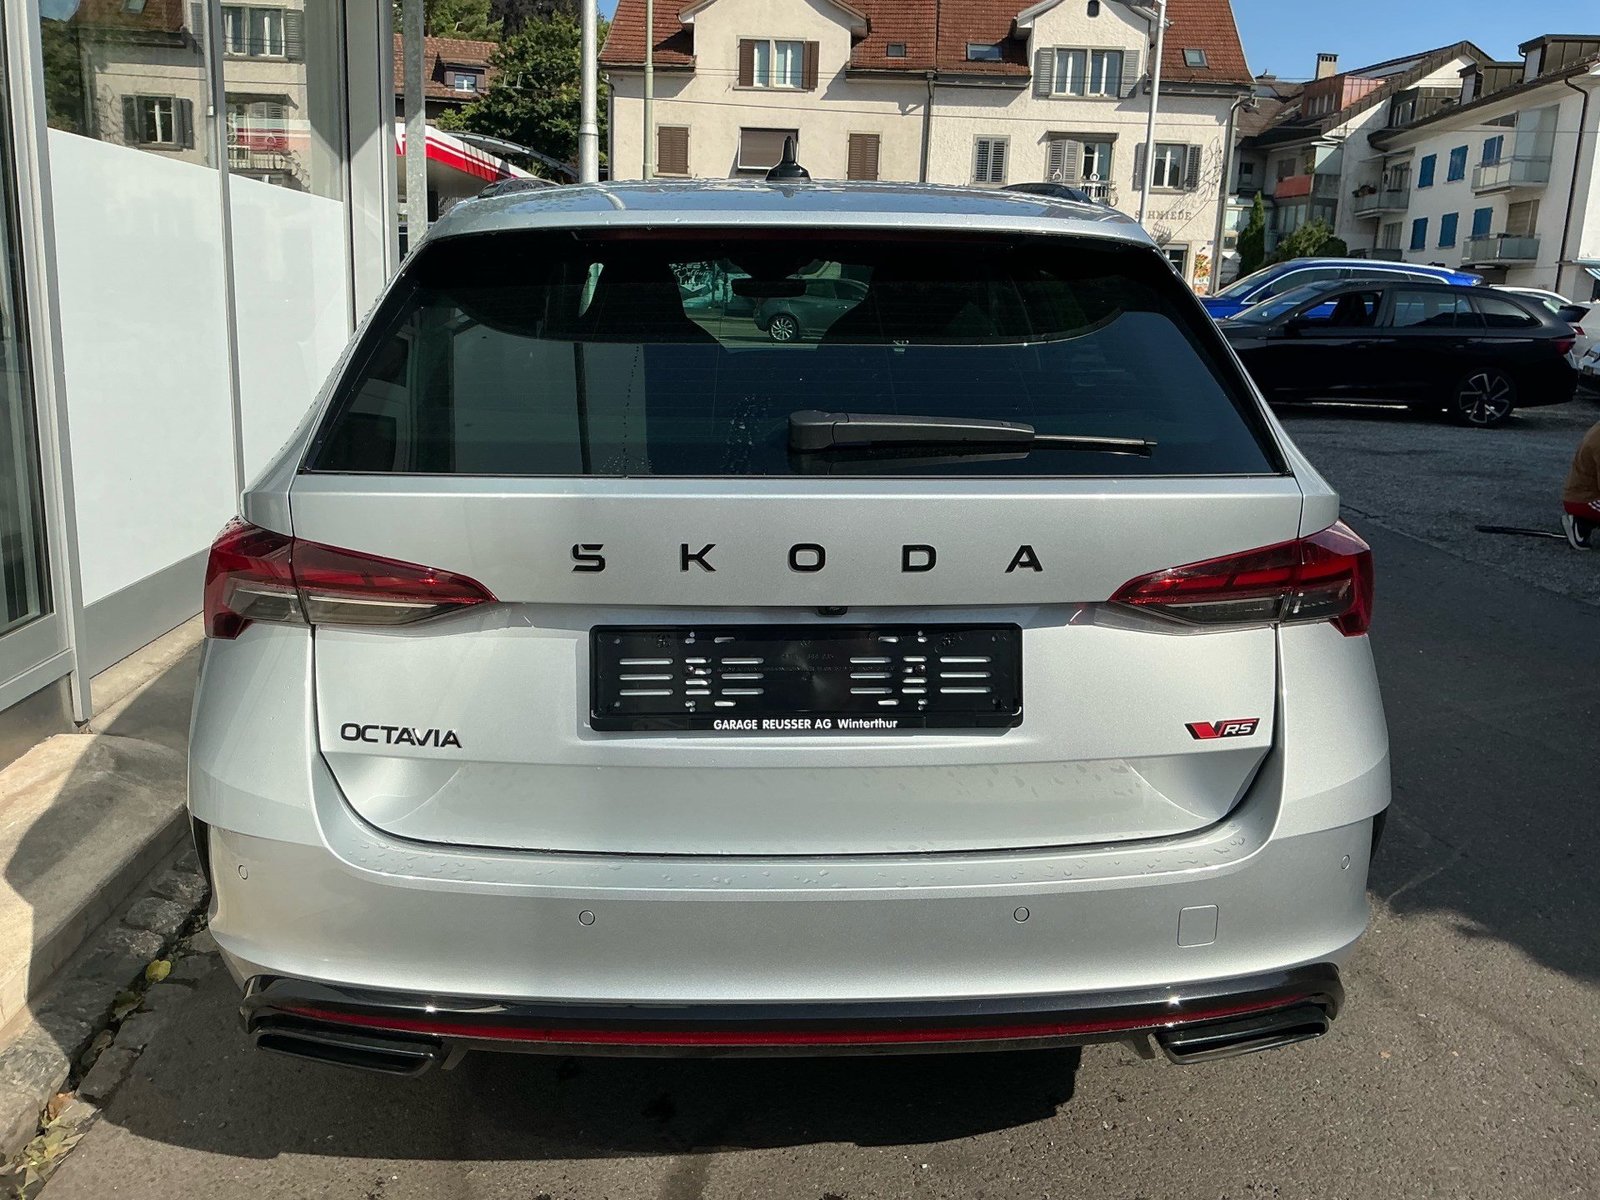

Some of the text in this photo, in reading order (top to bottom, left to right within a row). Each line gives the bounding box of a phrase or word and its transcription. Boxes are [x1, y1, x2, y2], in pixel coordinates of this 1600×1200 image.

[1134, 210, 1192, 221] SHMIEDE
[572, 543, 1043, 573] SKODA
[713, 718, 898, 730] GARAGE REUSSER AG Winterthur
[340, 722, 462, 748] OCTAVIA
